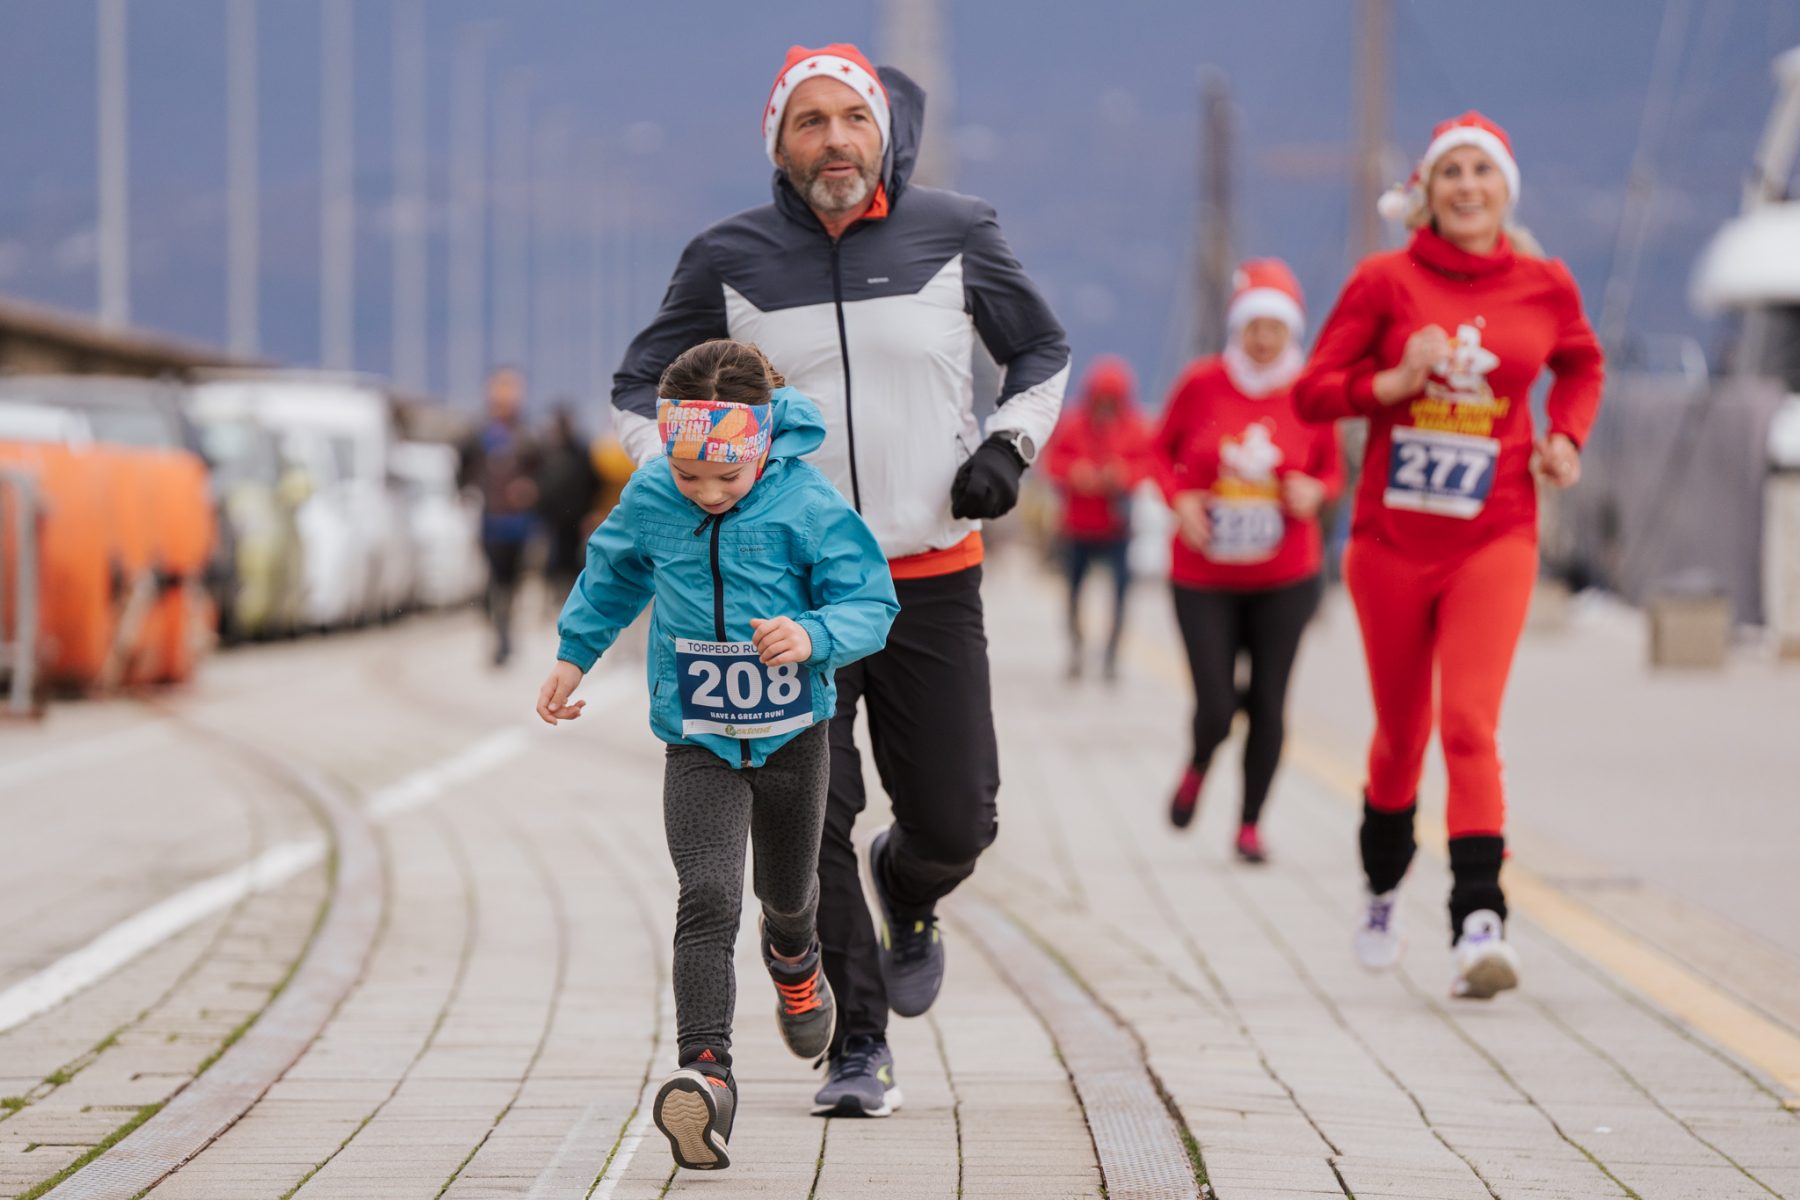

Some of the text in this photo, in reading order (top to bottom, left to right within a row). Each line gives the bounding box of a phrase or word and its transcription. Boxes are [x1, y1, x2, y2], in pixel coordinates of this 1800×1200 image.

[1395, 442, 1489, 496] 277
[688, 642, 759, 654] TORPEDO RU
[688, 660, 801, 709] 208
[710, 711, 729, 719] HAVE
[737, 712, 763, 720] GREAT
[764, 709, 784, 719] RUN!
